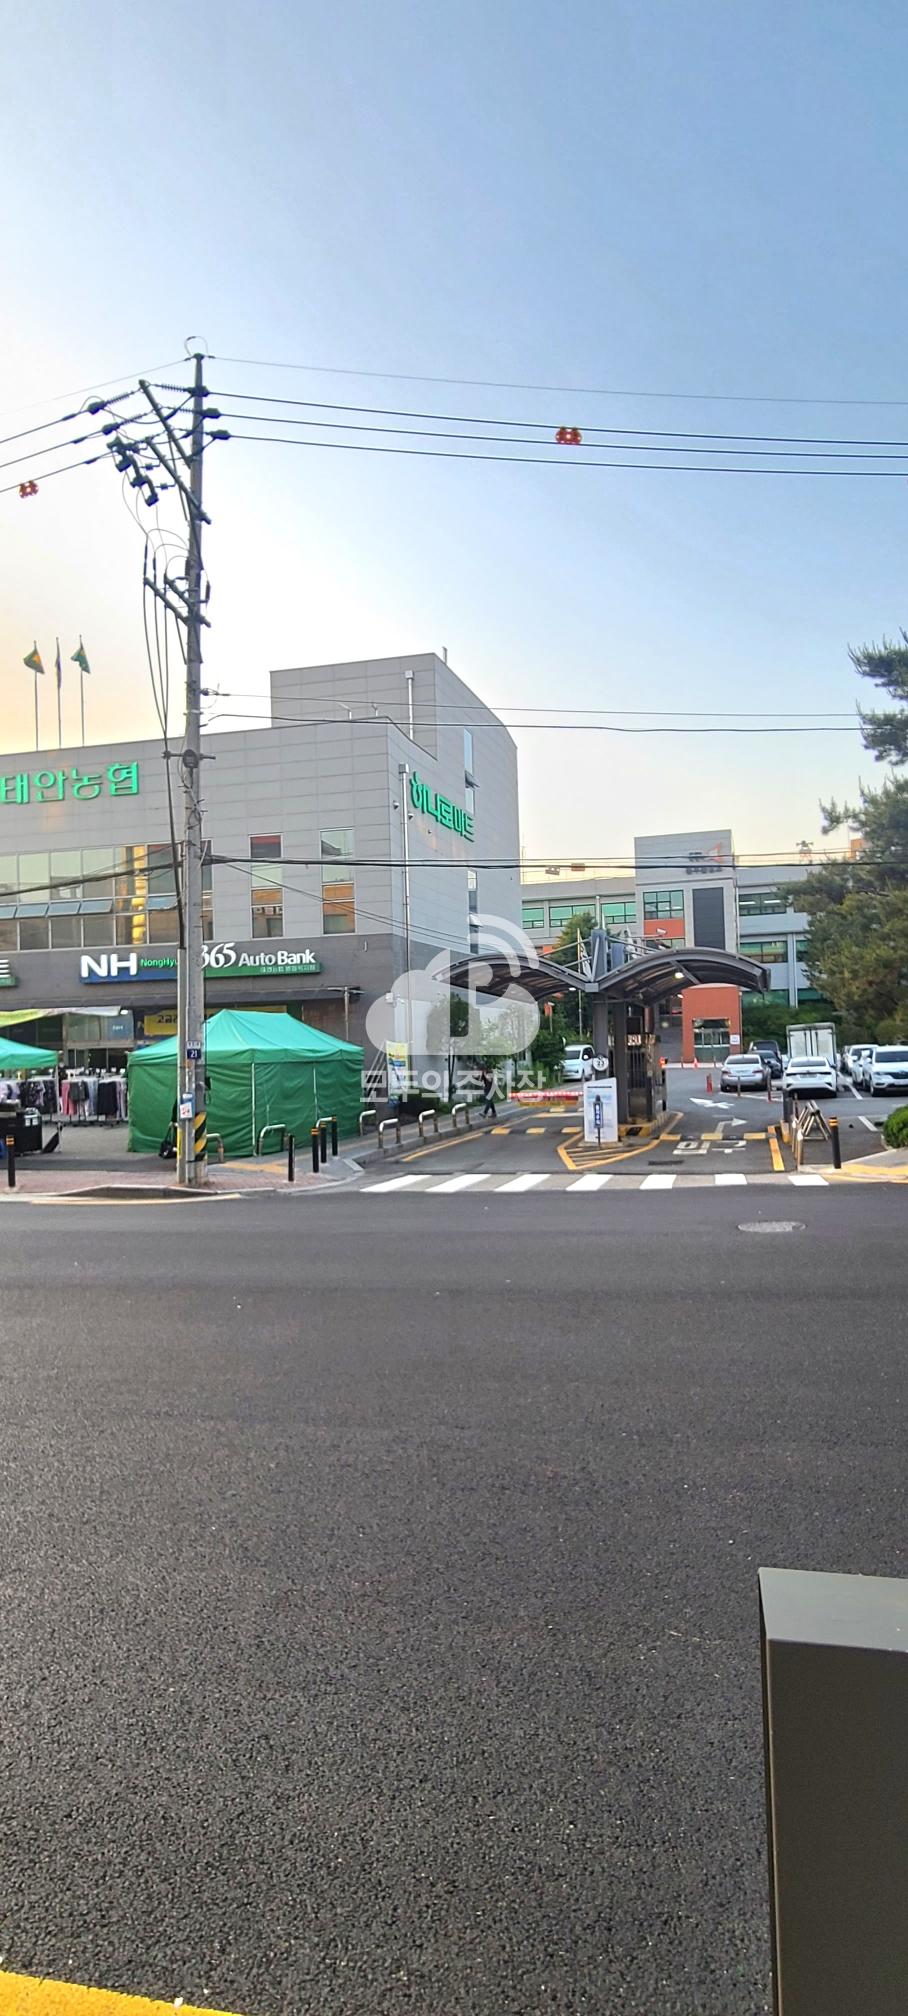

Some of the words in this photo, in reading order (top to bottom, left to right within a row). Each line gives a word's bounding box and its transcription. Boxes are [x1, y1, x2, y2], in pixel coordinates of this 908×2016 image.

[0, 761, 139, 804] 태안농협
[80, 952, 138, 978] NH
[140, 957, 177, 968] NongHy
[238, 952, 276, 967] Auto
[277, 948, 316, 965] Bank
